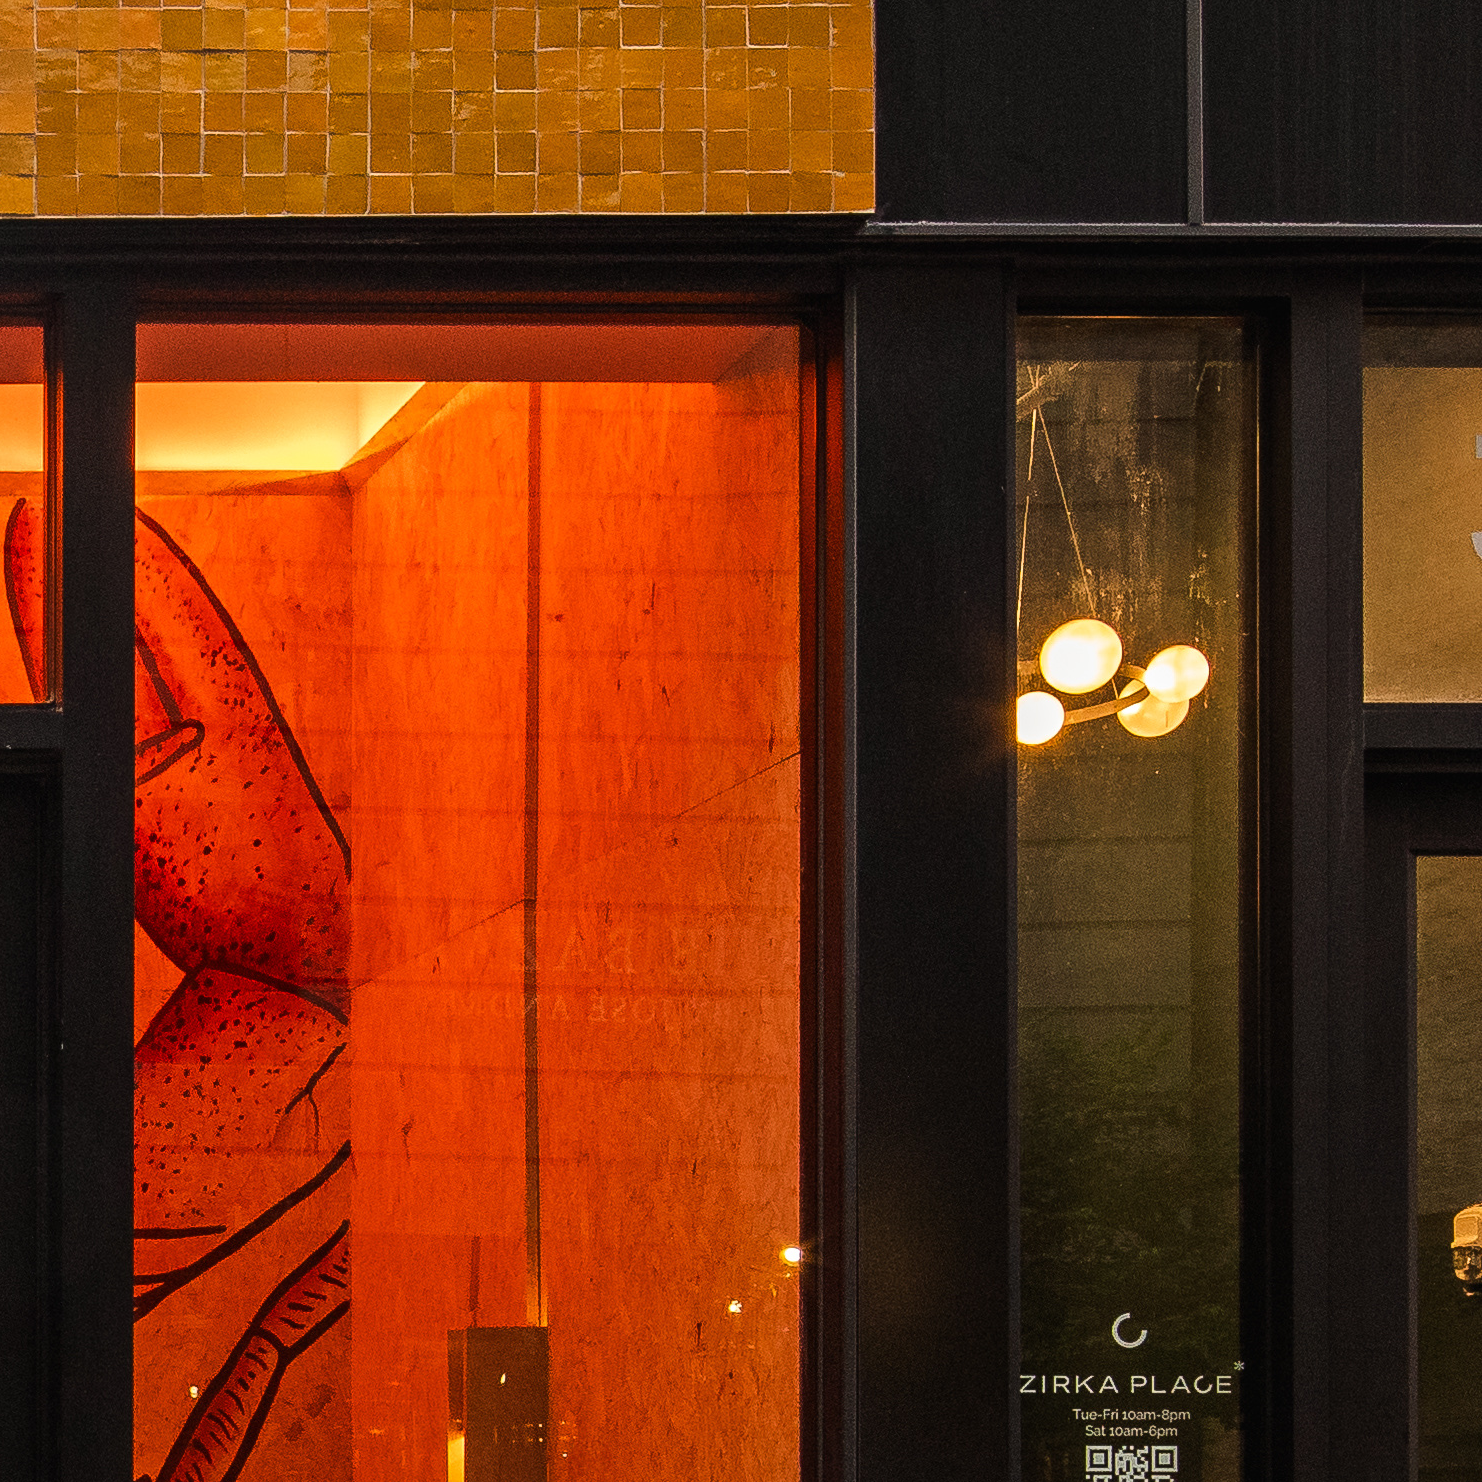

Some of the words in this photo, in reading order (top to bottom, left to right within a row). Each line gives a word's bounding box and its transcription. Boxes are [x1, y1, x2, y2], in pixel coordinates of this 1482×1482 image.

[1019, 1375, 1119, 1394] ZIRKA
[1130, 1375, 1232, 1394] PLACE
[1072, 1408, 1119, 1421] Tue-Fri
[1121, 1408, 1191, 1422] 10am-8pm
[1085, 1425, 1106, 1437] Sat
[1109, 1425, 1178, 1439] 10am-6pm
